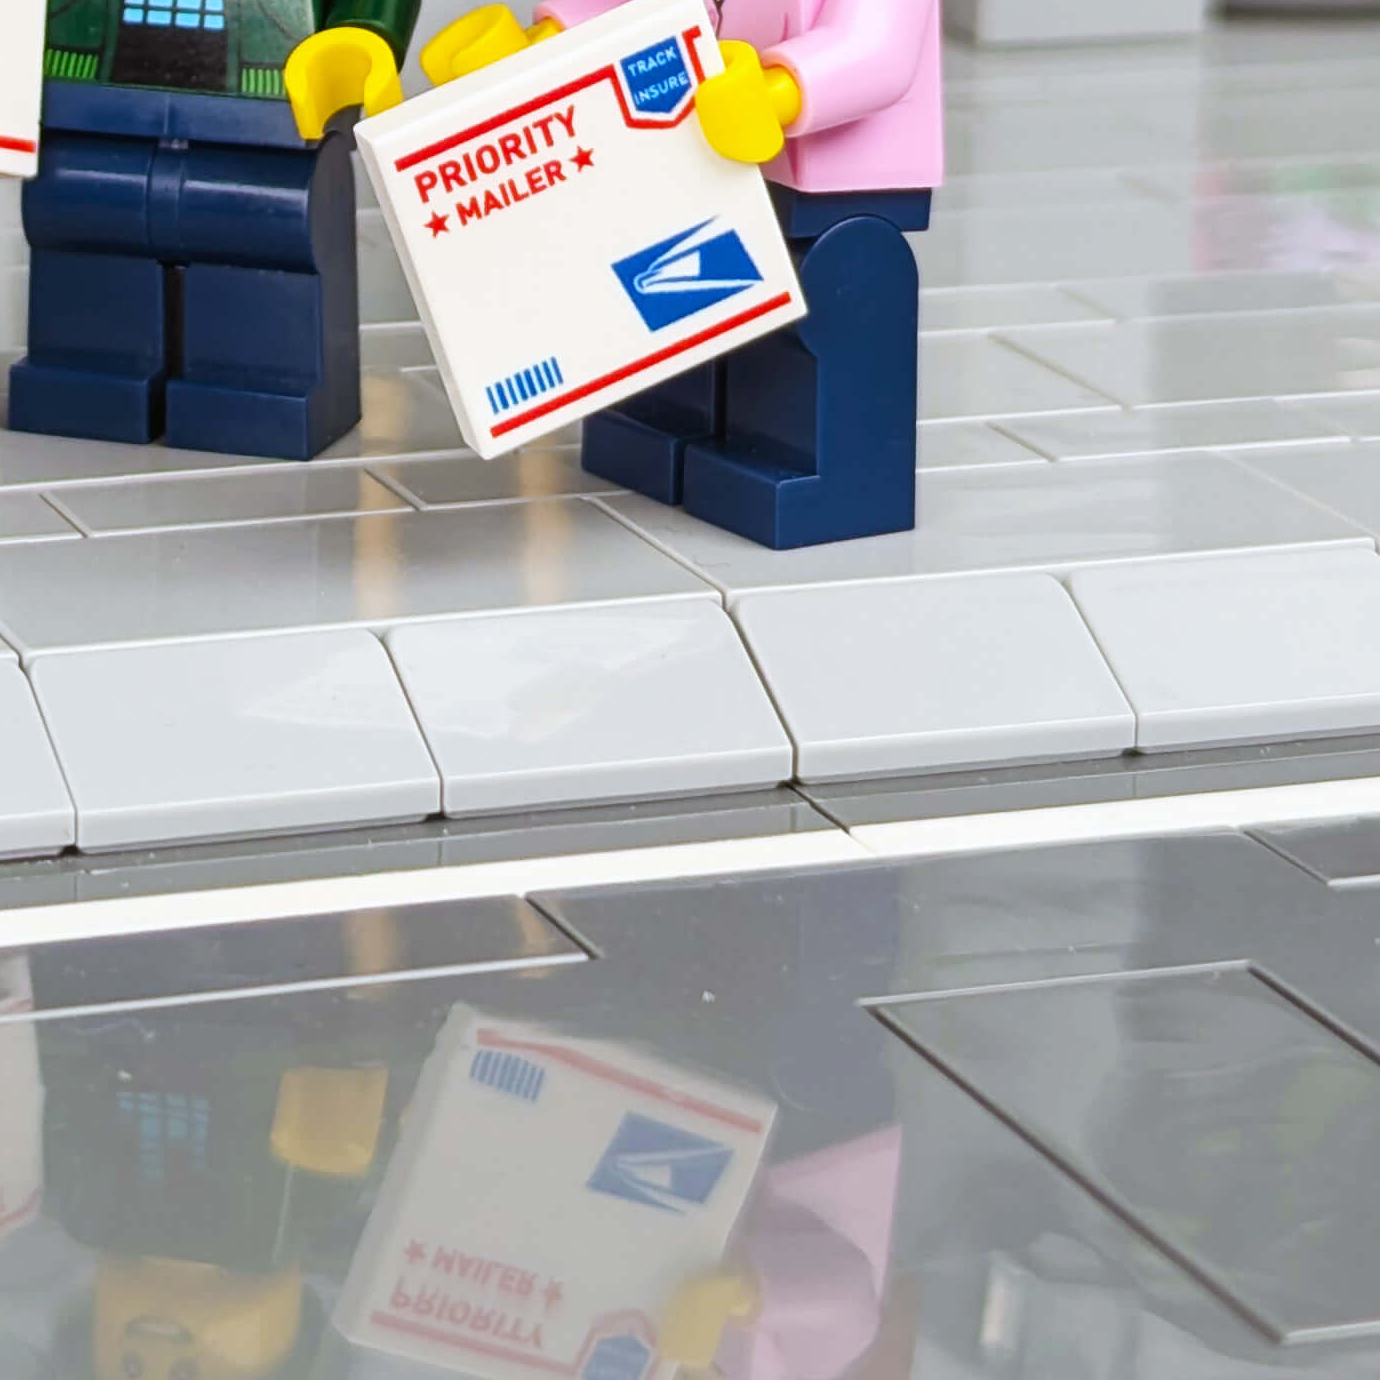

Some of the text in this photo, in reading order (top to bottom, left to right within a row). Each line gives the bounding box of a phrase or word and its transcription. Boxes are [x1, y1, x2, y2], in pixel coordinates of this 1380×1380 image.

[627, 46, 677, 77] TRACK
[634, 70, 689, 106] INSURE
[413, 104, 578, 204] PRIORITY
[455, 158, 567, 227] MAILER
